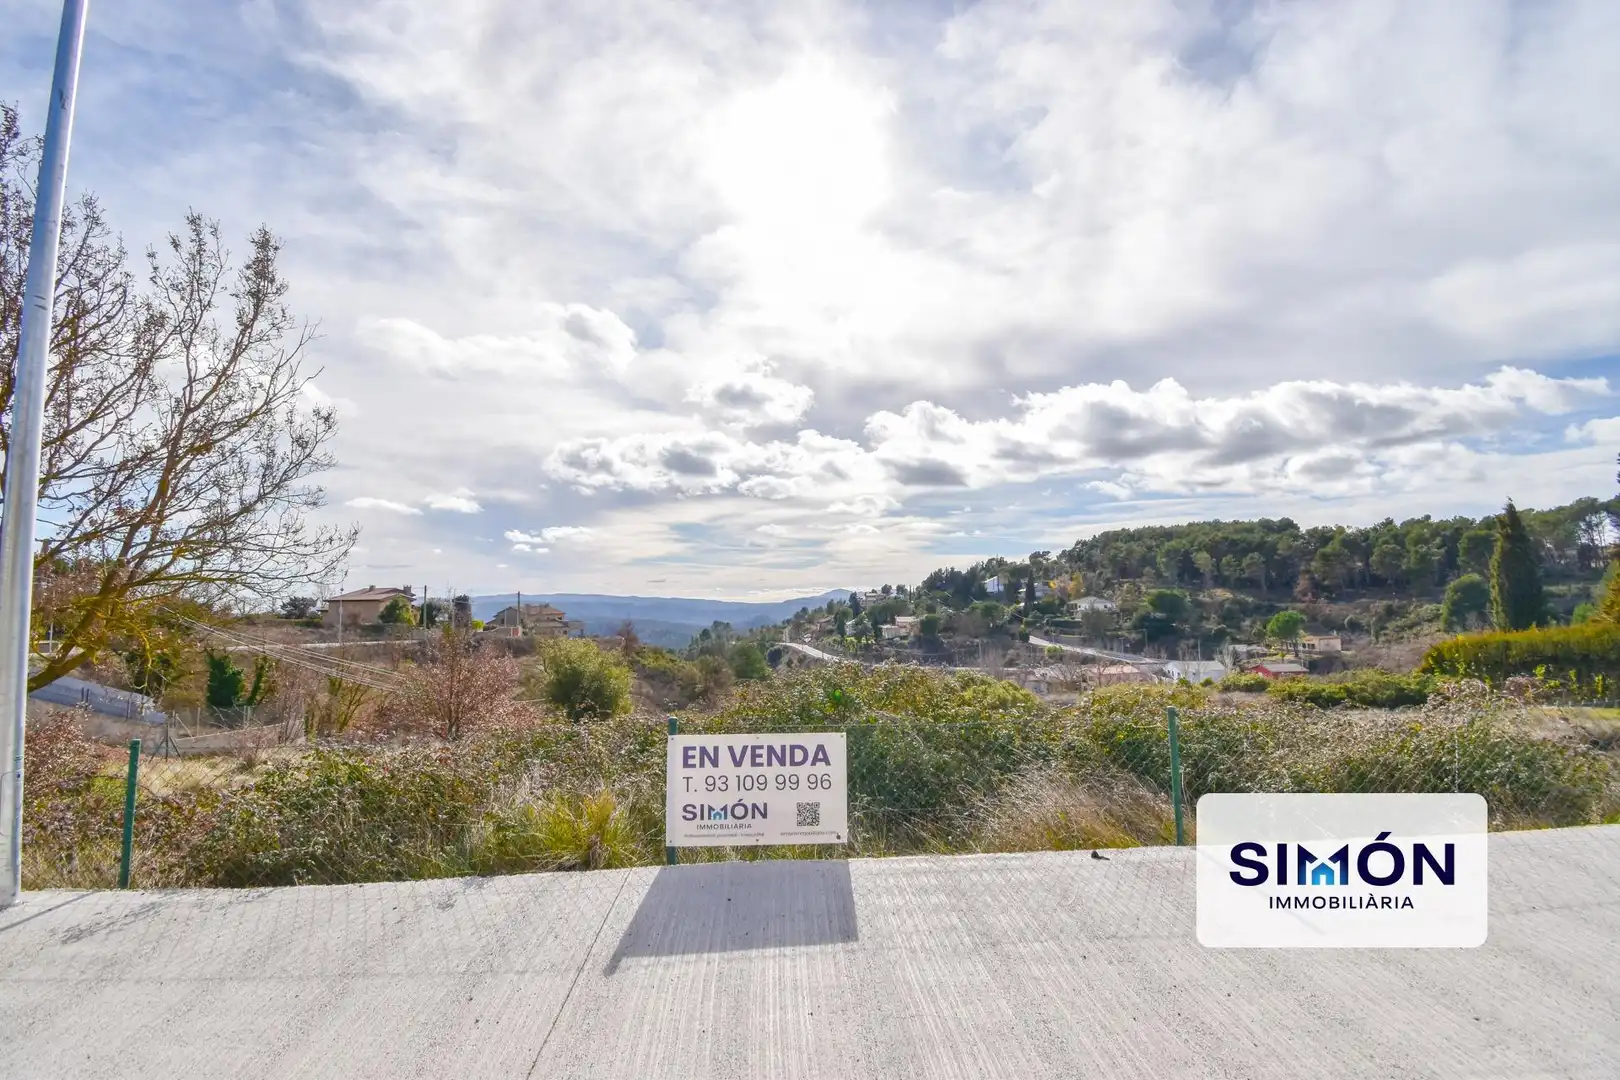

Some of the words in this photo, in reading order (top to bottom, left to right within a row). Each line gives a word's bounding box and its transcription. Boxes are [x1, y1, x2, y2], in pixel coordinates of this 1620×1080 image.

[682, 745, 720, 769] EN
[727, 744, 832, 768] VENDA
[682, 776, 698, 793] T.
[704, 774, 729, 793] 93
[735, 773, 768, 792] 109
[775, 773, 800, 791] 99
[807, 773, 832, 791] 96
[681, 798, 768, 822] SIMÓN
